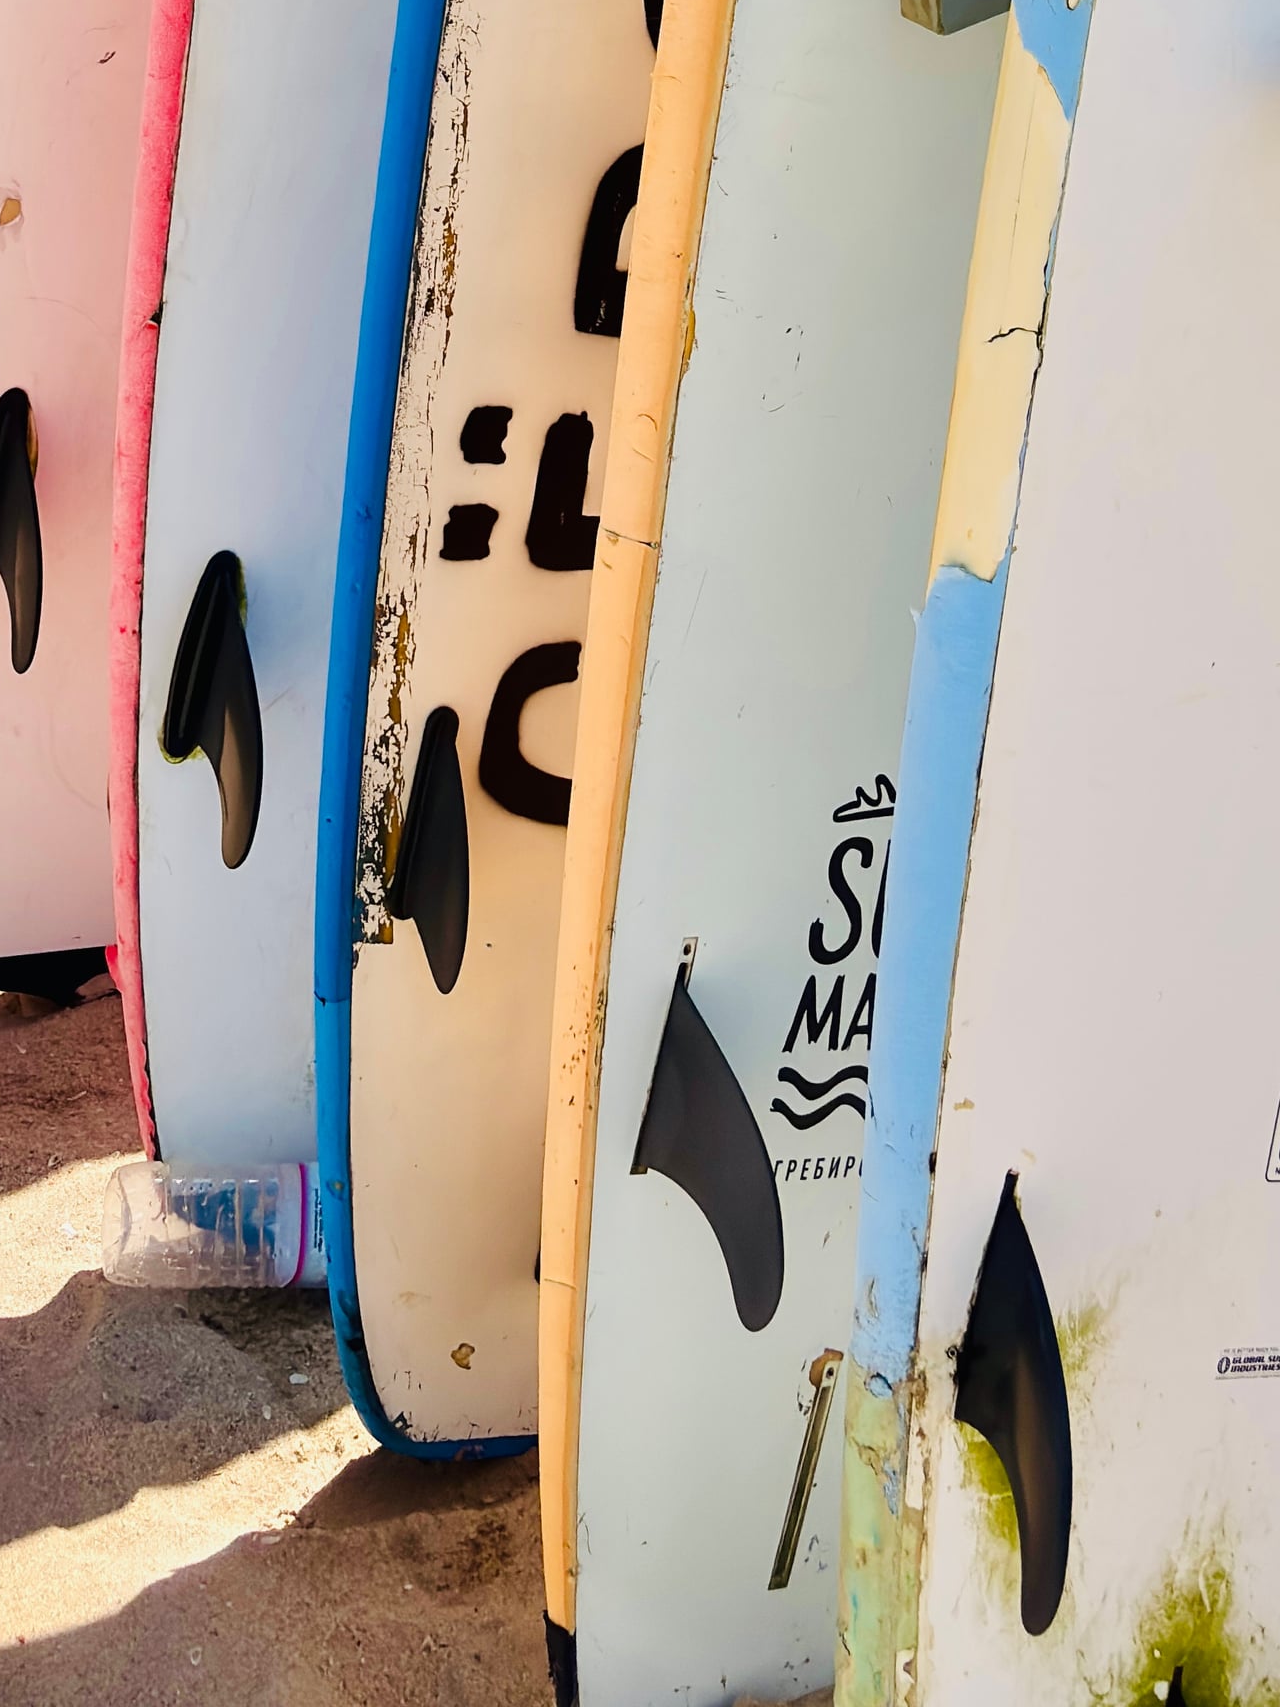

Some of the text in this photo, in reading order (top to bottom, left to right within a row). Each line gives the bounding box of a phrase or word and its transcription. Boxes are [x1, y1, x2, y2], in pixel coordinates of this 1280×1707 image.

[774, 1155, 863, 1182] ГРЕБИР
[1231, 1356, 1265, 1364] GLOBAL
[1230, 1363, 1280, 1372] INDUSTRIES
